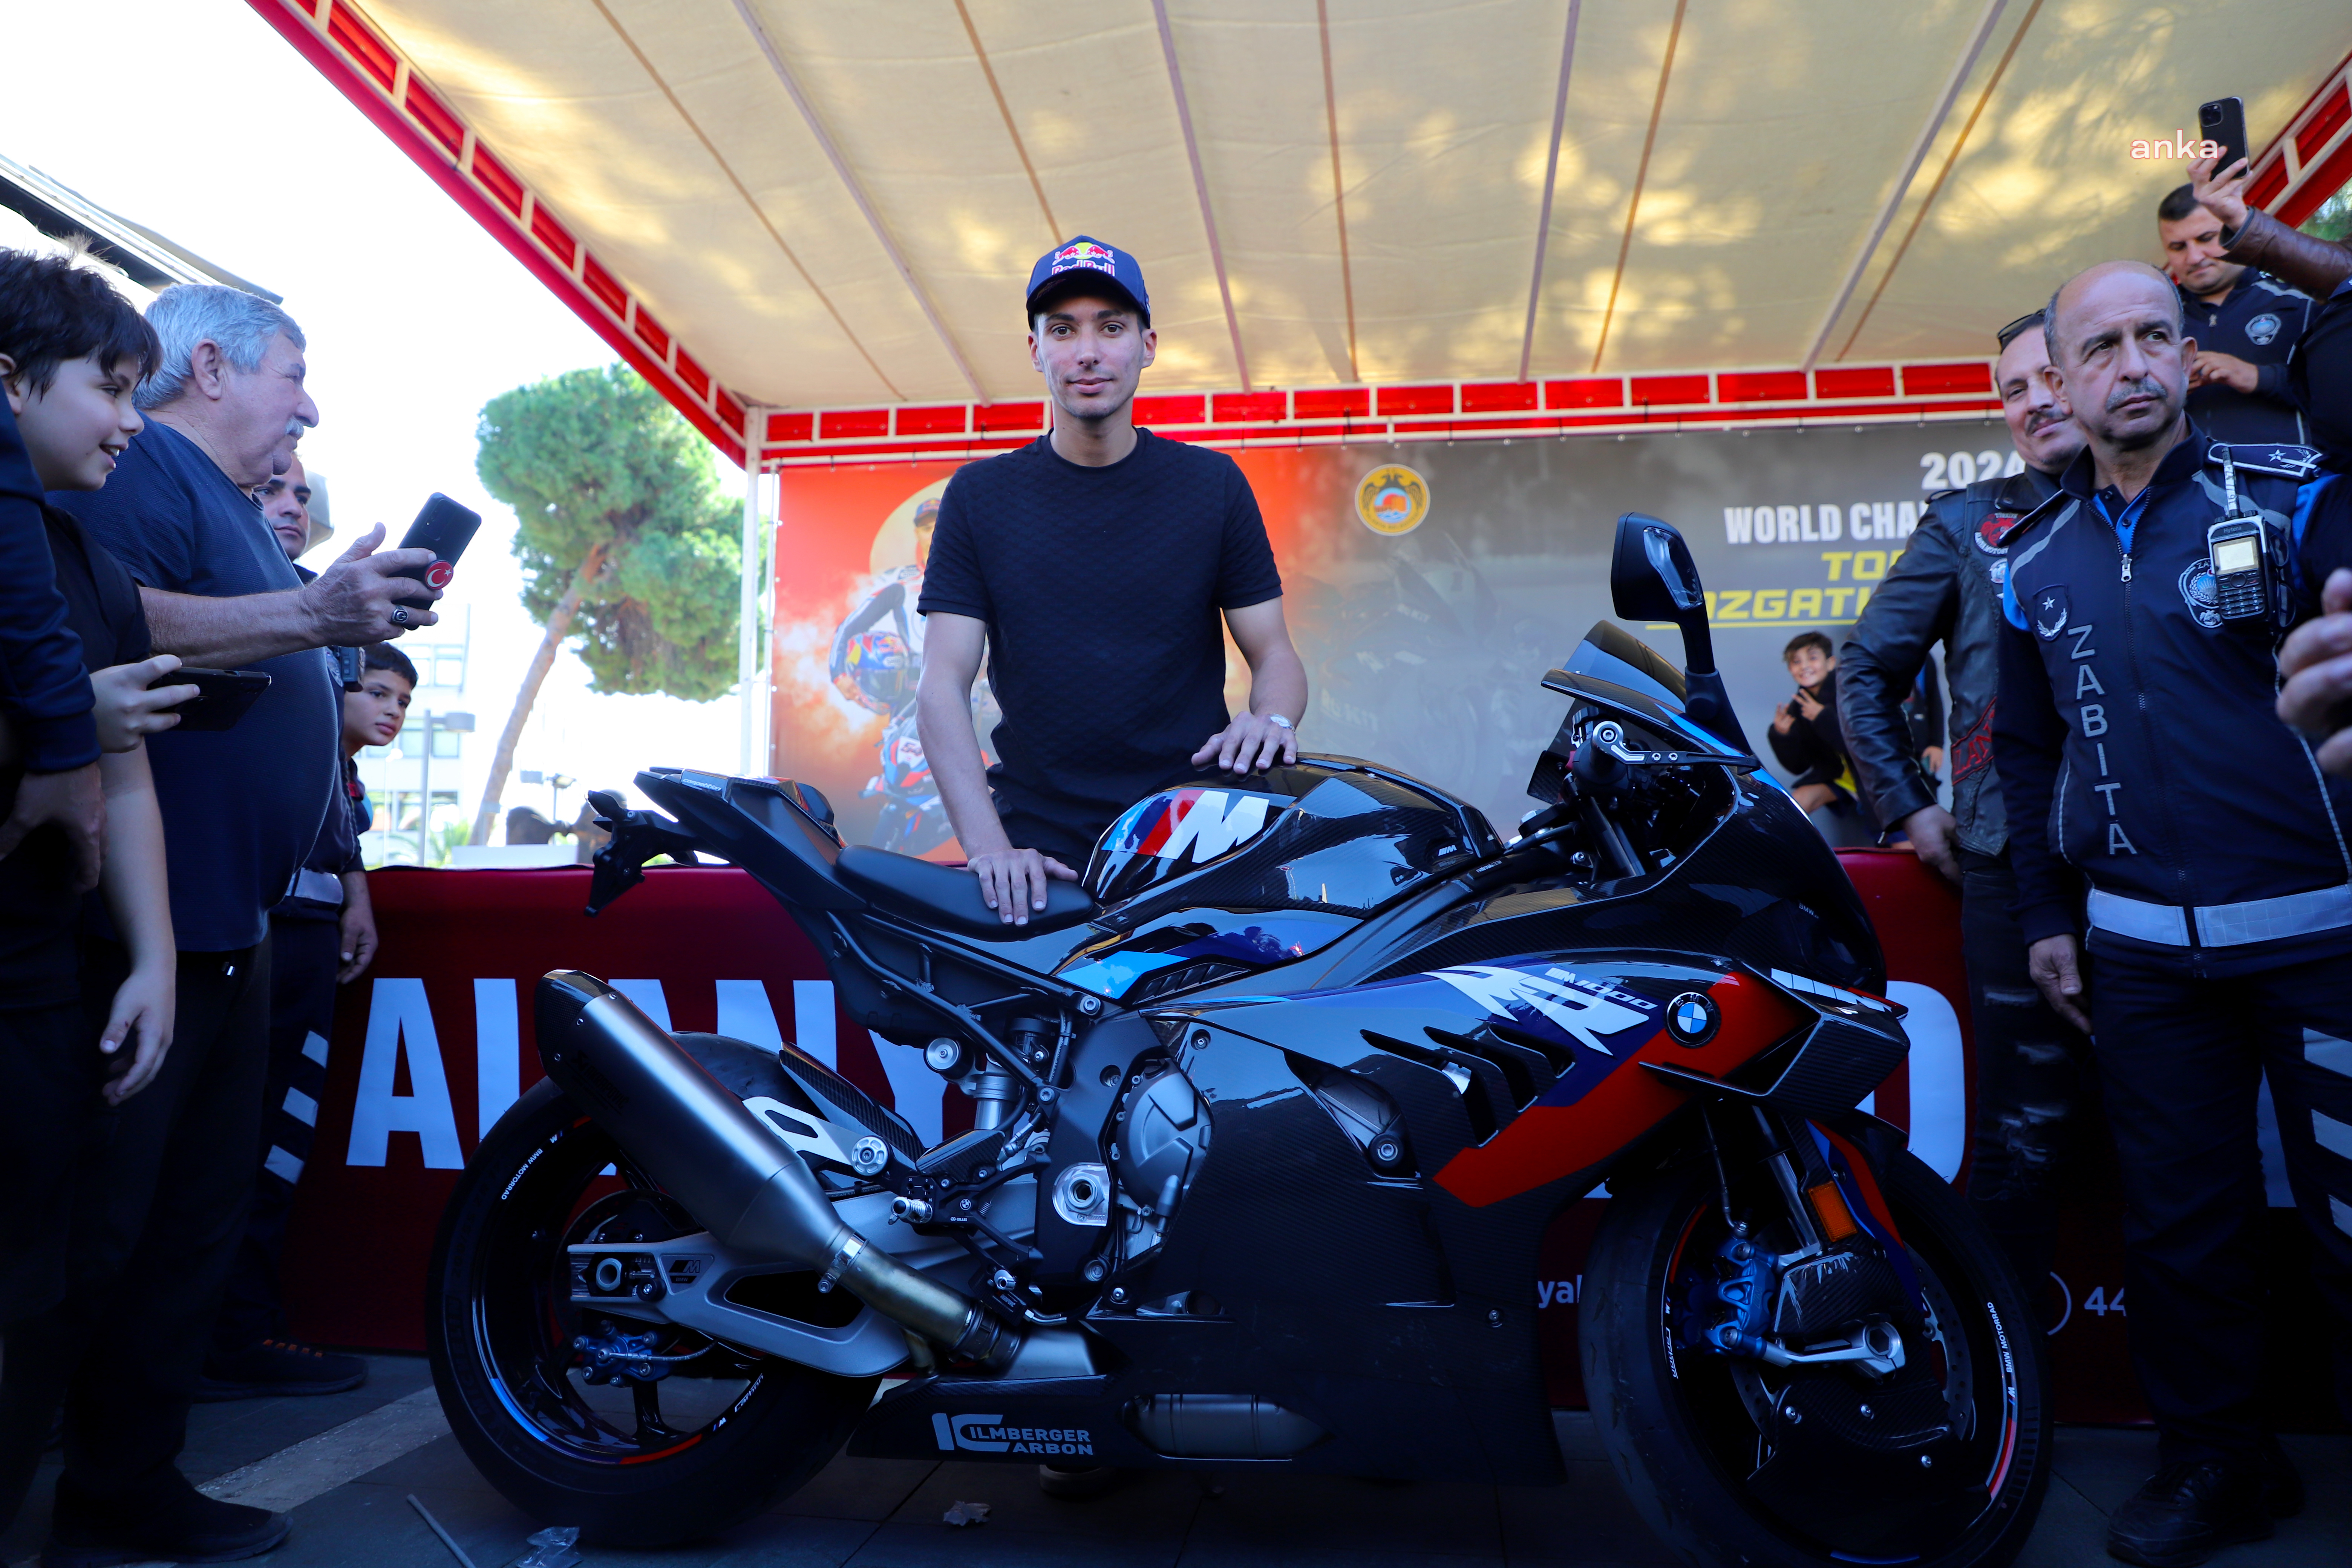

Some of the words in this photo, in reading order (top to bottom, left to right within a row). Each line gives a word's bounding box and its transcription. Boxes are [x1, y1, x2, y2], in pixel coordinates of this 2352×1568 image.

[1724, 504, 1842, 544] WORLD
[1850, 501, 1928, 540] CHA
[2067, 624, 2138, 855] ZABITA
[683, 778, 722, 791] competition
[1799, 903, 1814, 916] BMW
[1674, 994, 1714, 1012] BMW
[528, 1148, 543, 1165] BMW
[501, 1163, 529, 1200] MOTORRAD
[1987, 1302, 2008, 1349] MOTORRAD
[2004, 1351, 2013, 1373] BMW
